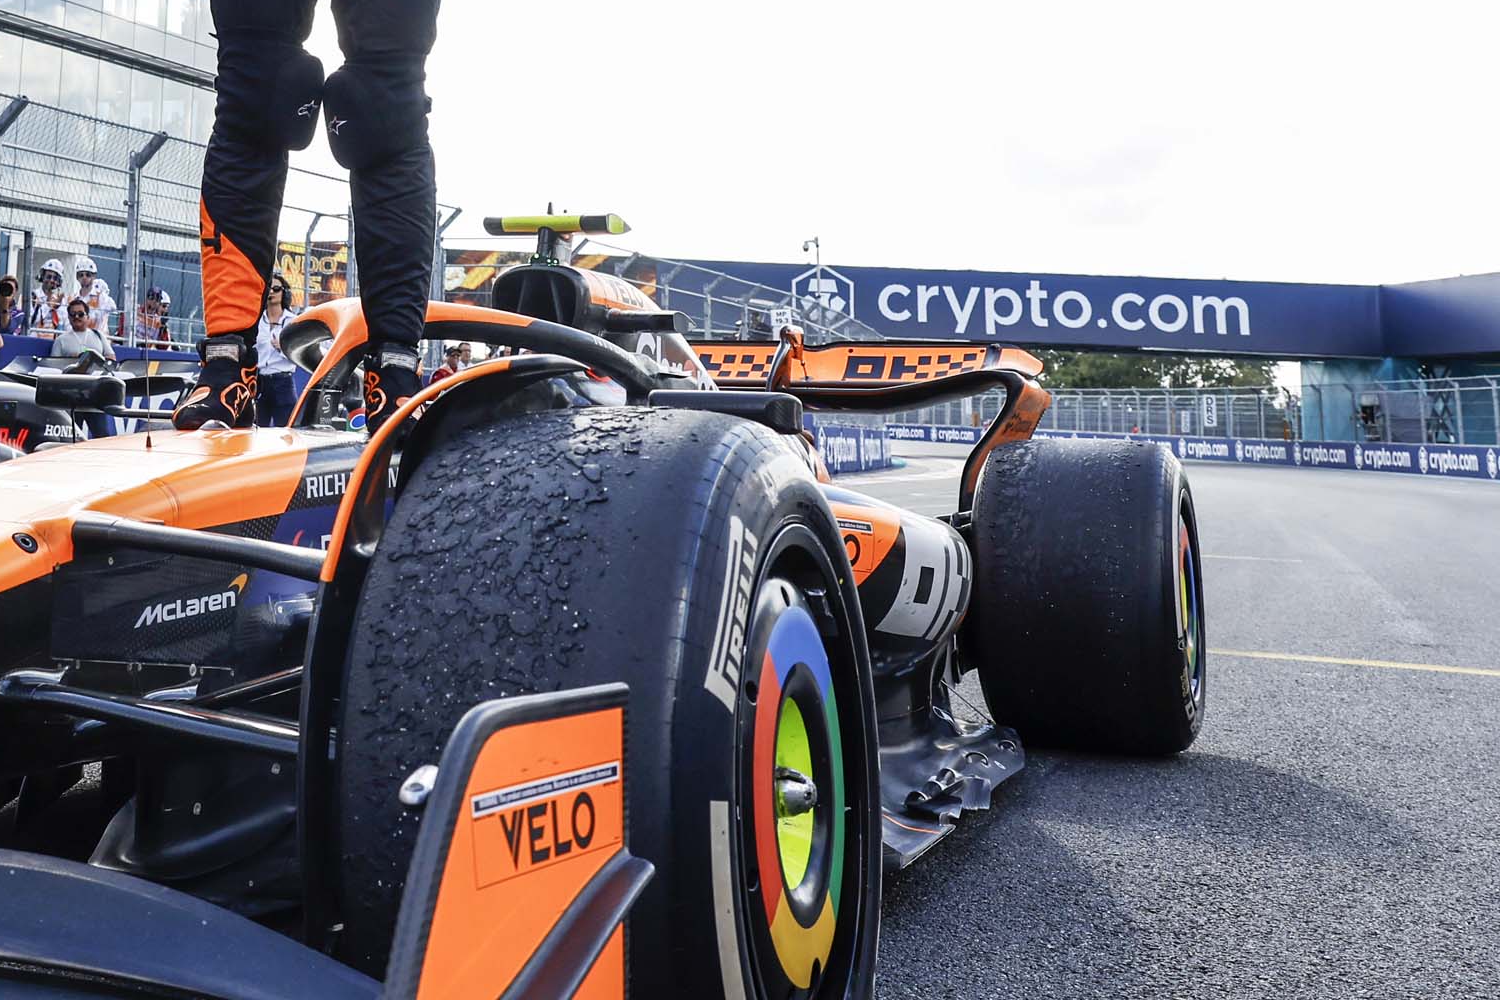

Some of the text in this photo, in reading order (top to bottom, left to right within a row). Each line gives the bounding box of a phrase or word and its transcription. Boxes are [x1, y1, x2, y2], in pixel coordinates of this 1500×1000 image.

[878, 280, 1250, 336] crypto.com
[1205, 396, 1214, 425] DRS
[1188, 440, 1229, 458] crypto.com
[1244, 443, 1287, 462] crypto.com
[1303, 446, 1347, 464] crypto.com
[1364, 448, 1411, 468] crypto.com
[1429, 450, 1479, 472] crypto.com
[305, 473, 347, 499] RICH
[134, 588, 237, 629] McLaren
[705, 515, 759, 715] PIRELLI
[499, 791, 595, 871] VELO
